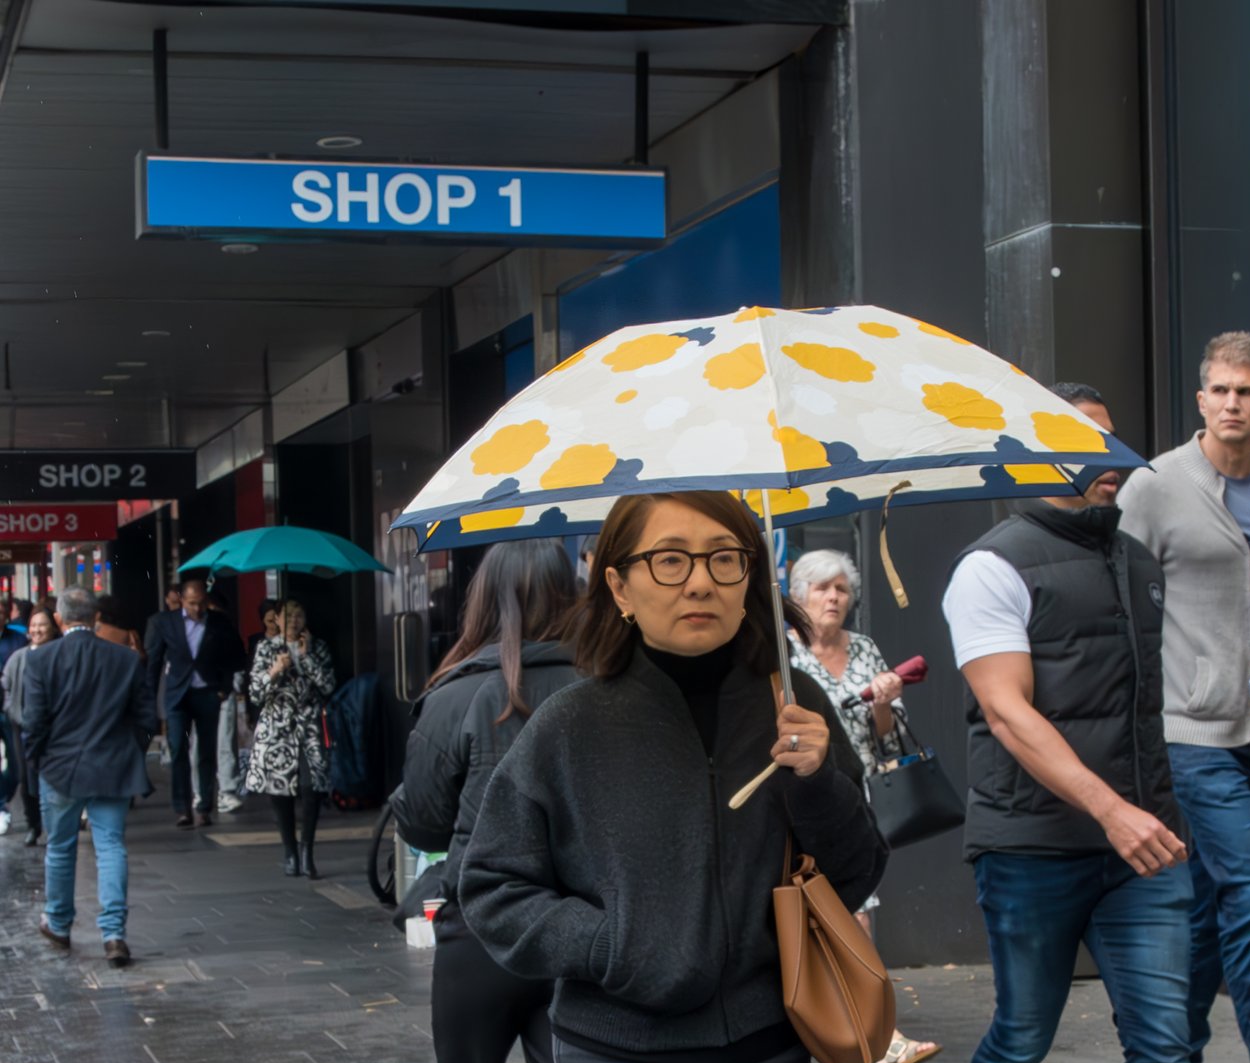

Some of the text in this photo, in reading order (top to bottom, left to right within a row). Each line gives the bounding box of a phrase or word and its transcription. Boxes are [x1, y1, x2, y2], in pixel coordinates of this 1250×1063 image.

[291, 170, 522, 228] SHOP 1
[39, 464, 147, 488] SHOP 2
[64, 513, 78, 532] 3
